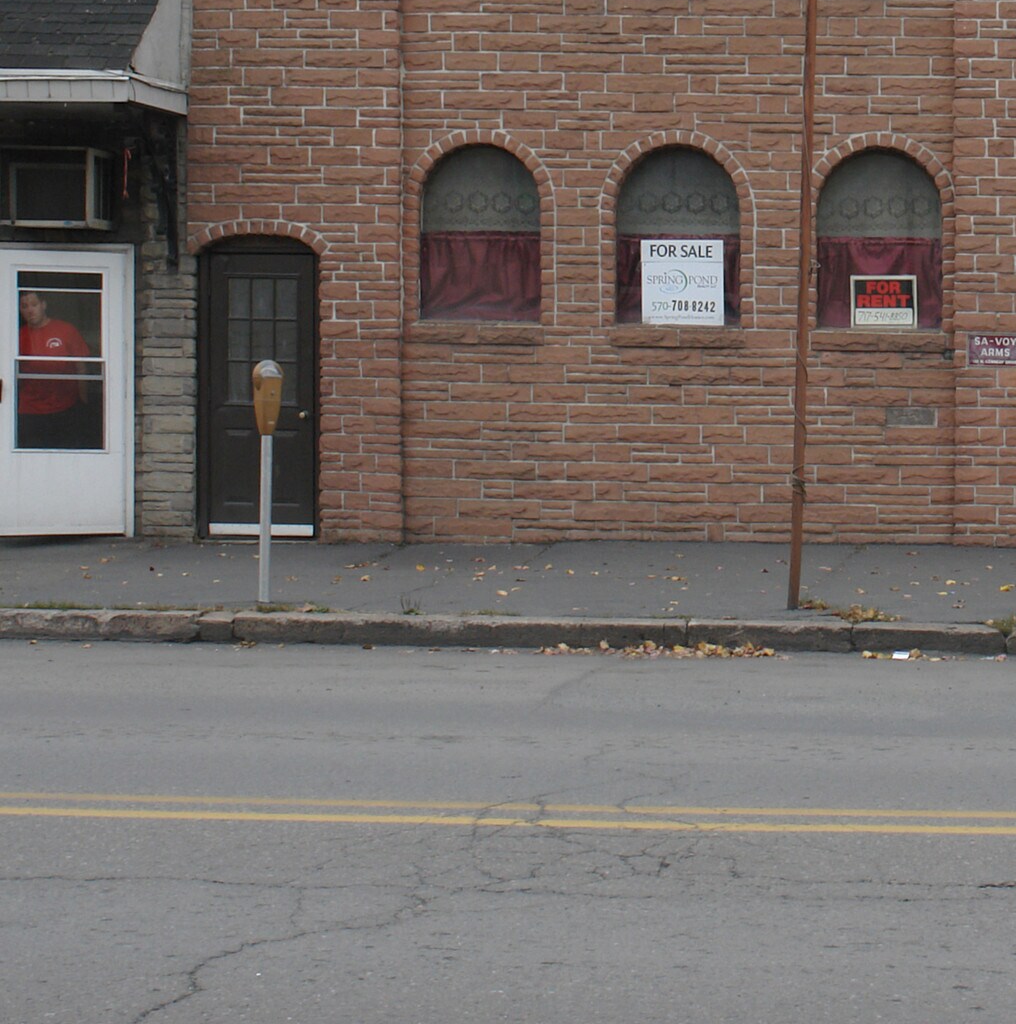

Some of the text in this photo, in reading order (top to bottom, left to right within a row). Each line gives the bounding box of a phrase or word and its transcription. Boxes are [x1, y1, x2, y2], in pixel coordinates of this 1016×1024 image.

[650, 244, 713, 258] FOR SALE
[688, 275, 718, 285] POND
[865, 280, 901, 294] FOR
[857, 294, 911, 308] RENT
[980, 348, 1011, 357] ARMS
